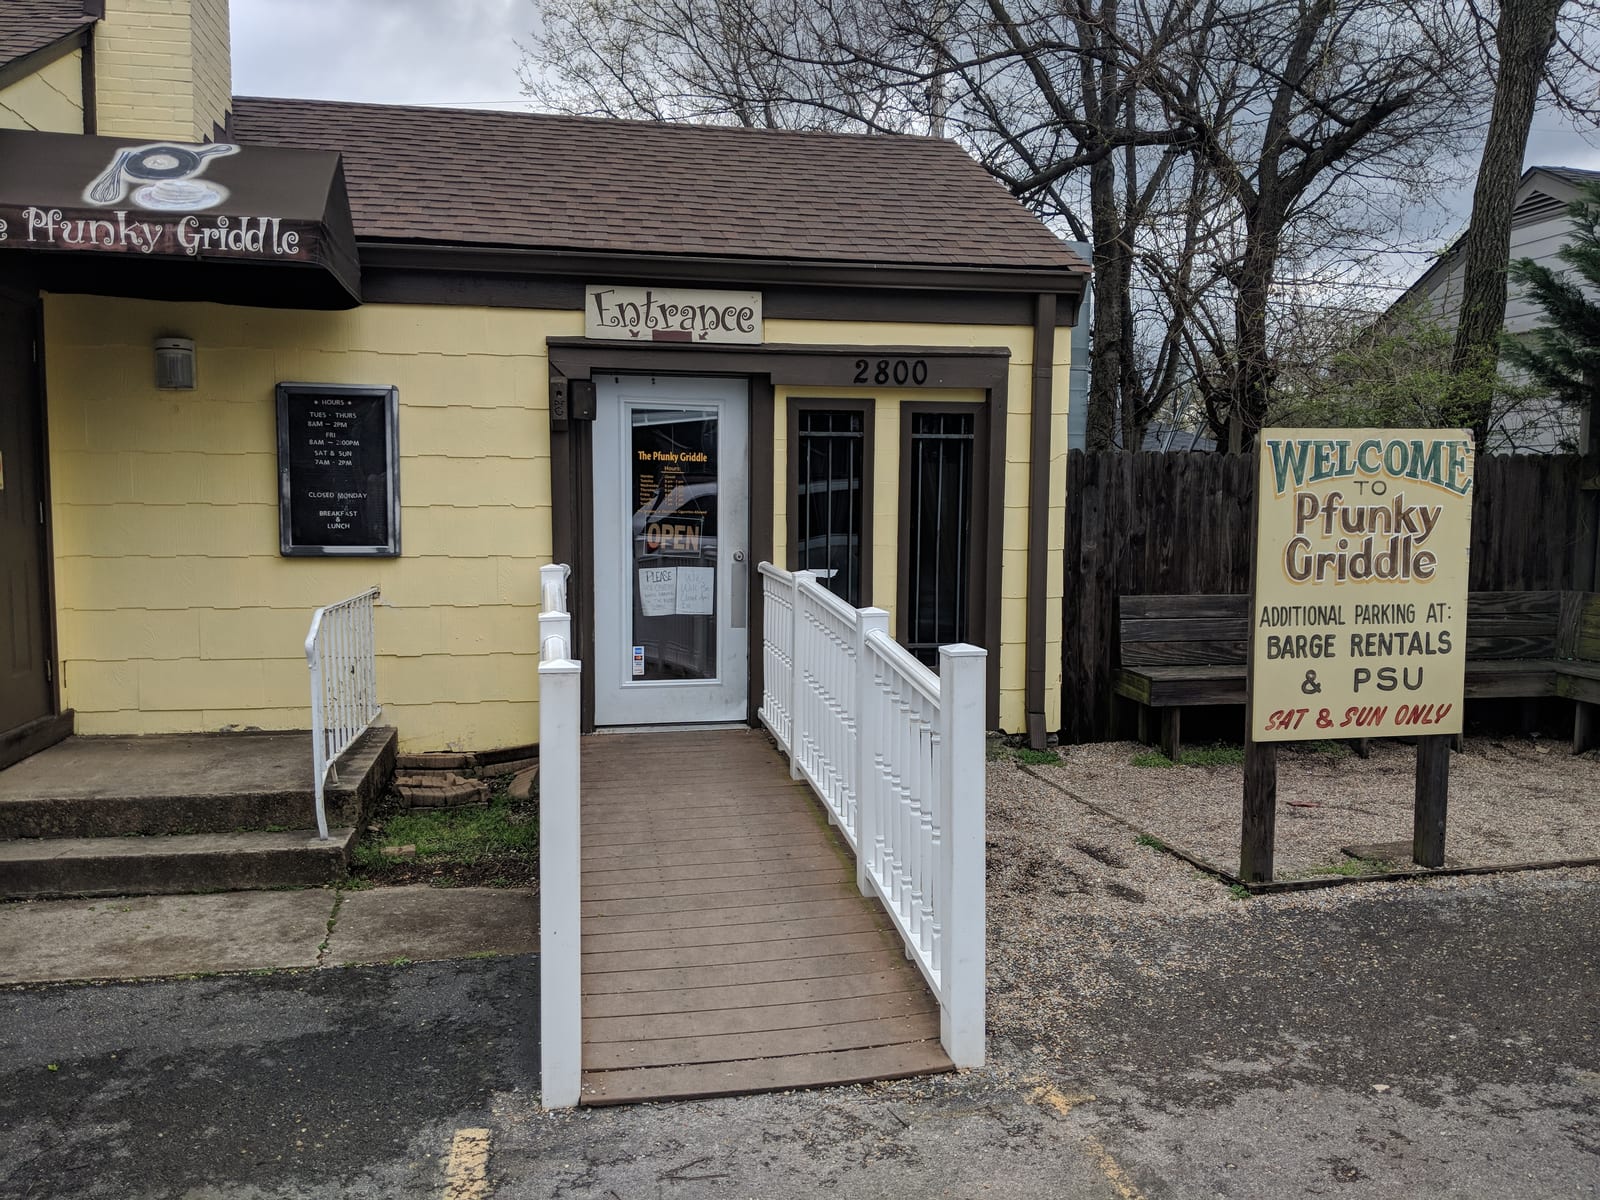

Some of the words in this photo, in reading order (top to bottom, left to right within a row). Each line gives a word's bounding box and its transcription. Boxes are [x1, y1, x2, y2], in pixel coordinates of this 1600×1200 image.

[23, 207, 162, 253] Pfunky
[177, 215, 299, 256] Griddle
[589, 289, 755, 334] Entrance
[853, 358, 928, 386] 2800
[638, 451, 652, 461] The
[653, 451, 679, 464] Pfunky
[680, 452, 708, 462] Griddle
[1265, 438, 1474, 497] WELCOME
[1353, 480, 1388, 496] TO
[1293, 490, 1443, 546] Pfunky
[647, 523, 699, 552] OPEN
[1283, 534, 1438, 583] Griddle
[646, 570, 673, 583] PLEASE
[1259, 604, 1346, 628] ADDITIONAL
[1354, 603, 1416, 626] PARKING
[1425, 602, 1453, 624] AT:
[1266, 633, 1337, 660] BARGE
[1350, 630, 1453, 658] RENTALS
[1301, 669, 1322, 695] &
[1353, 665, 1424, 693] PSU
[1265, 708, 1310, 731] SAT
[1315, 707, 1334, 729] &
[1339, 704, 1388, 729] SUN
[1394, 703, 1453, 727] ONLY
